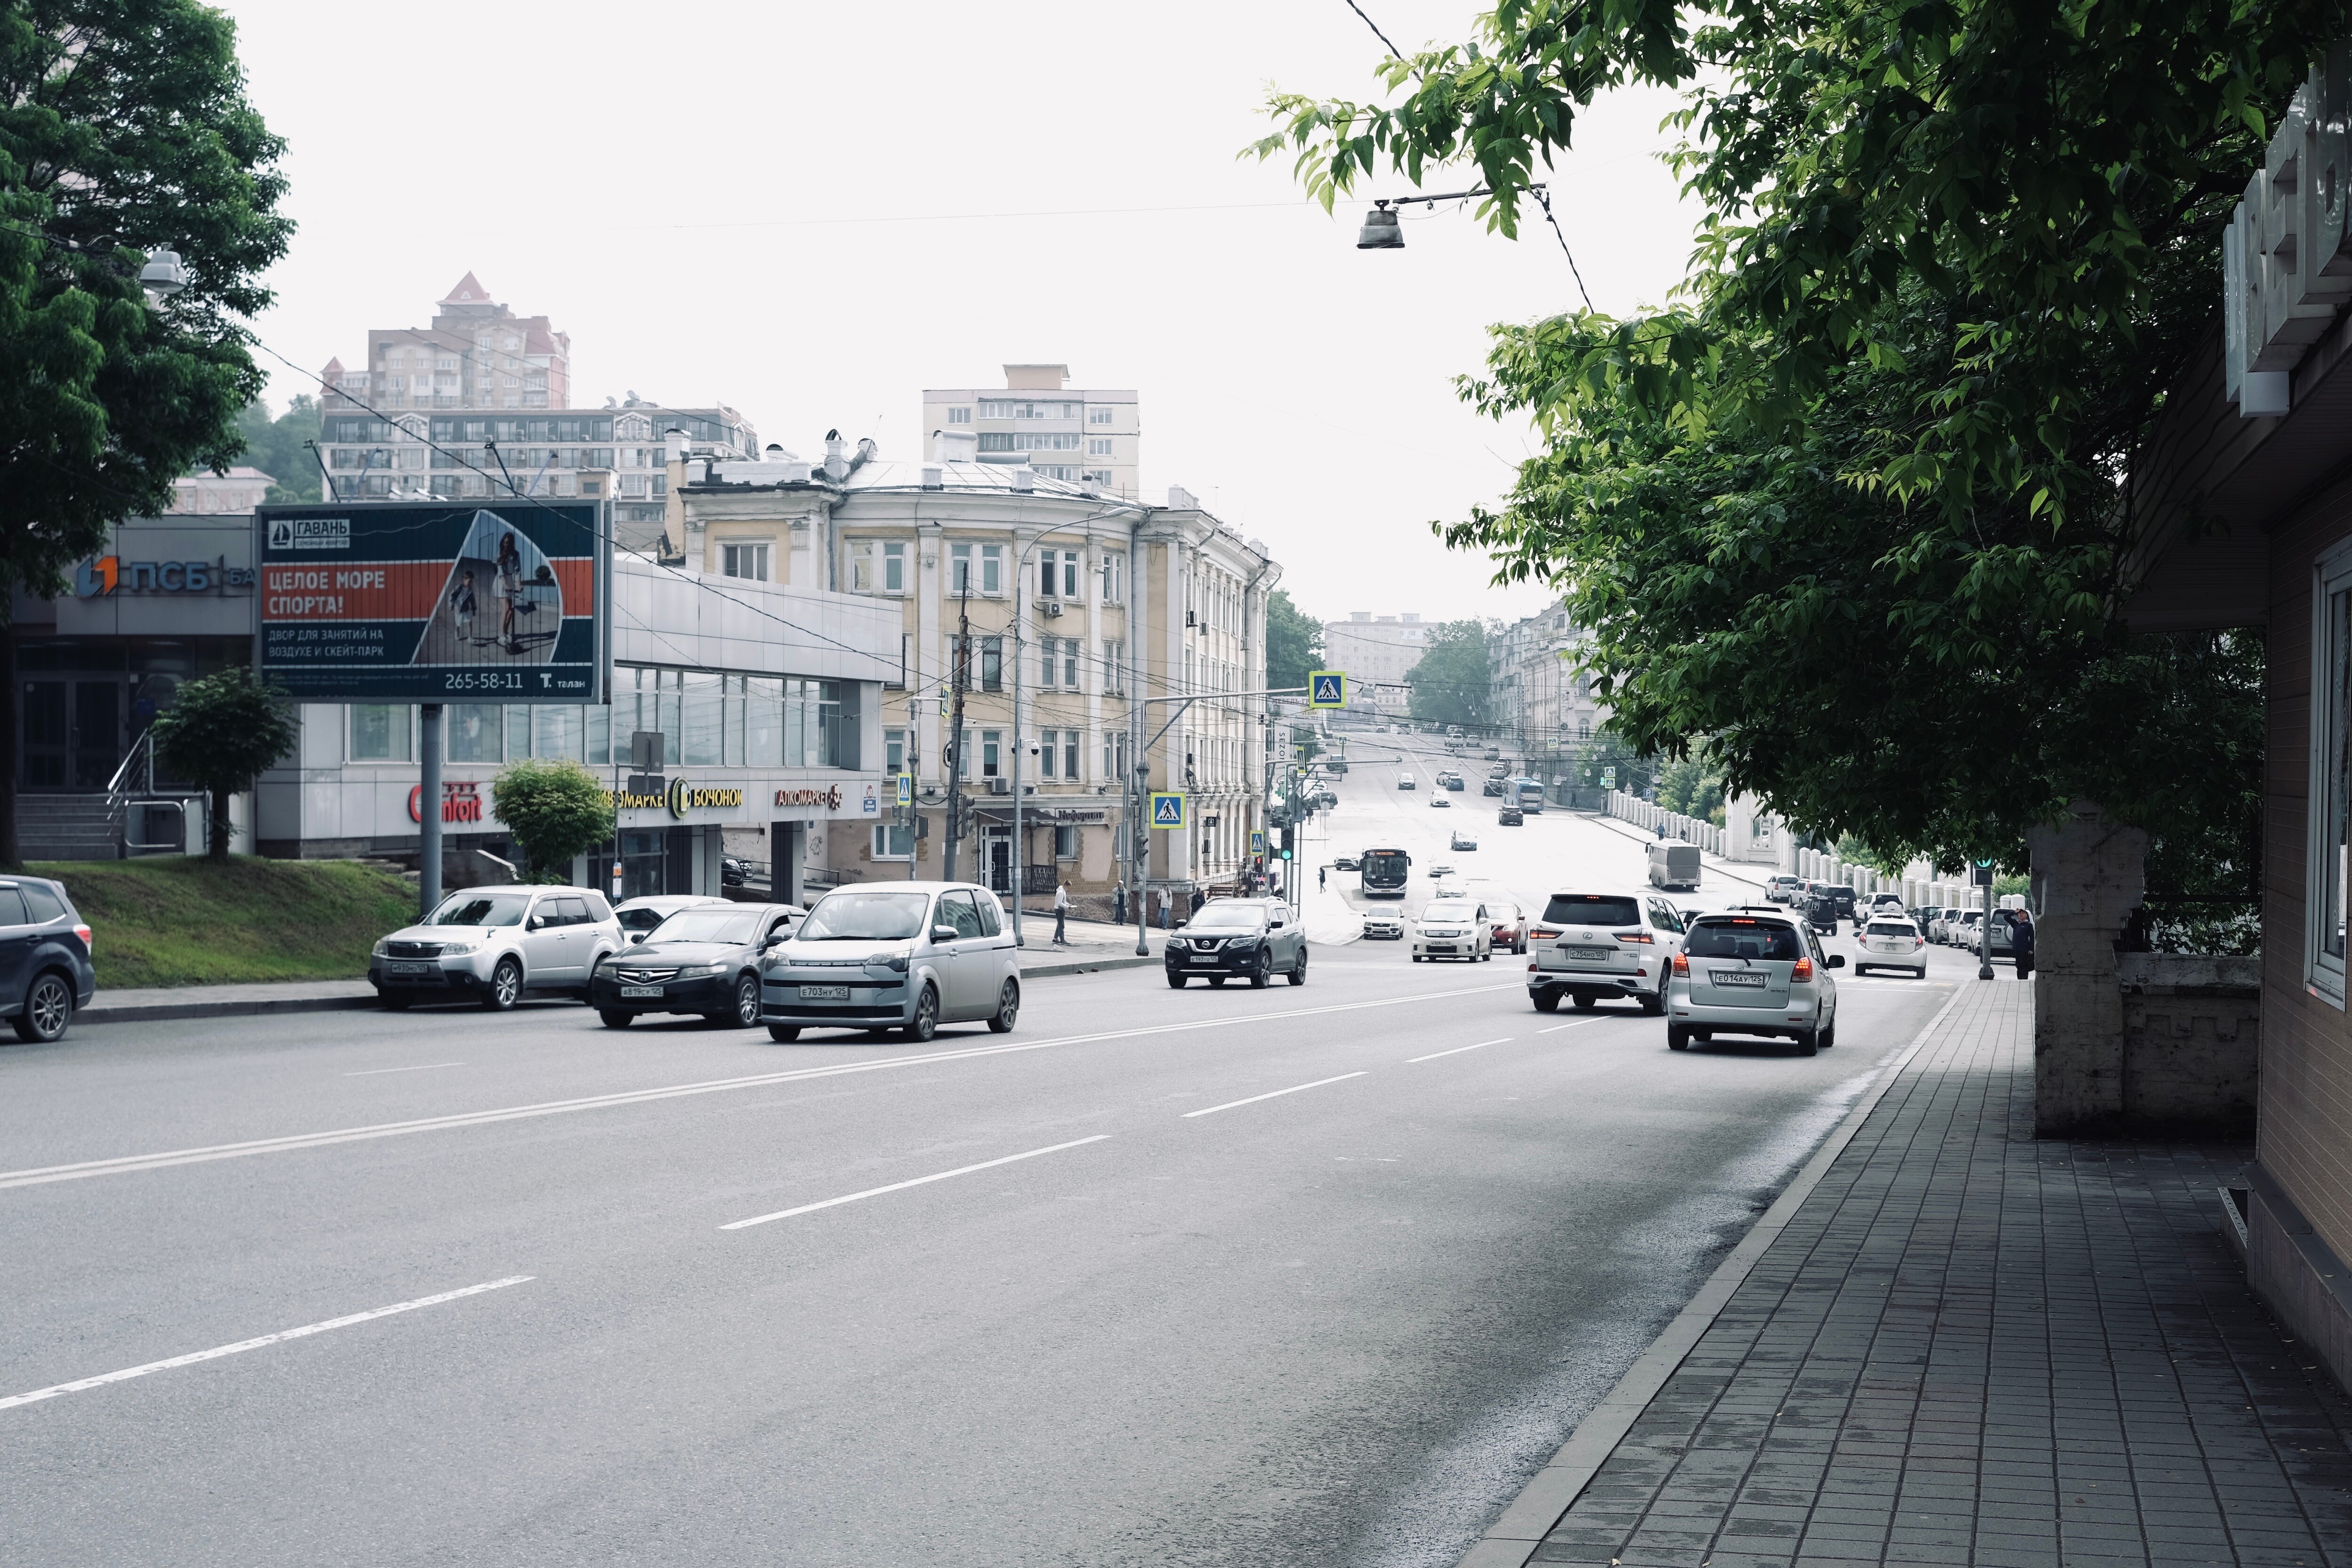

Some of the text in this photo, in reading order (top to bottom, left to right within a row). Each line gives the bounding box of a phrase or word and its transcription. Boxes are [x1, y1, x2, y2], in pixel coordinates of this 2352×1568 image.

[297, 522, 347, 534] ГАВАНЬ
[131, 561, 208, 591] ПСБ
[269, 571, 385, 593] ЦЕЛОЕ МОРЕ
[269, 596, 344, 614] СПОРТА!
[269, 628, 384, 642] ДВОР ДЛЯ ЗАНЯТИЙ НА
[269, 644, 384, 659] ВОЗДУХЕ И СКЕЙТ-ПАРК
[445, 673, 523, 689] 265-58-11
[694, 789, 743, 806] БОЧОНОК
[777, 789, 827, 806] АЛКОМАРКЕТ
[1718, 974, 1748, 983] Е014АУ
[802, 987, 833, 996] Е703НУ
